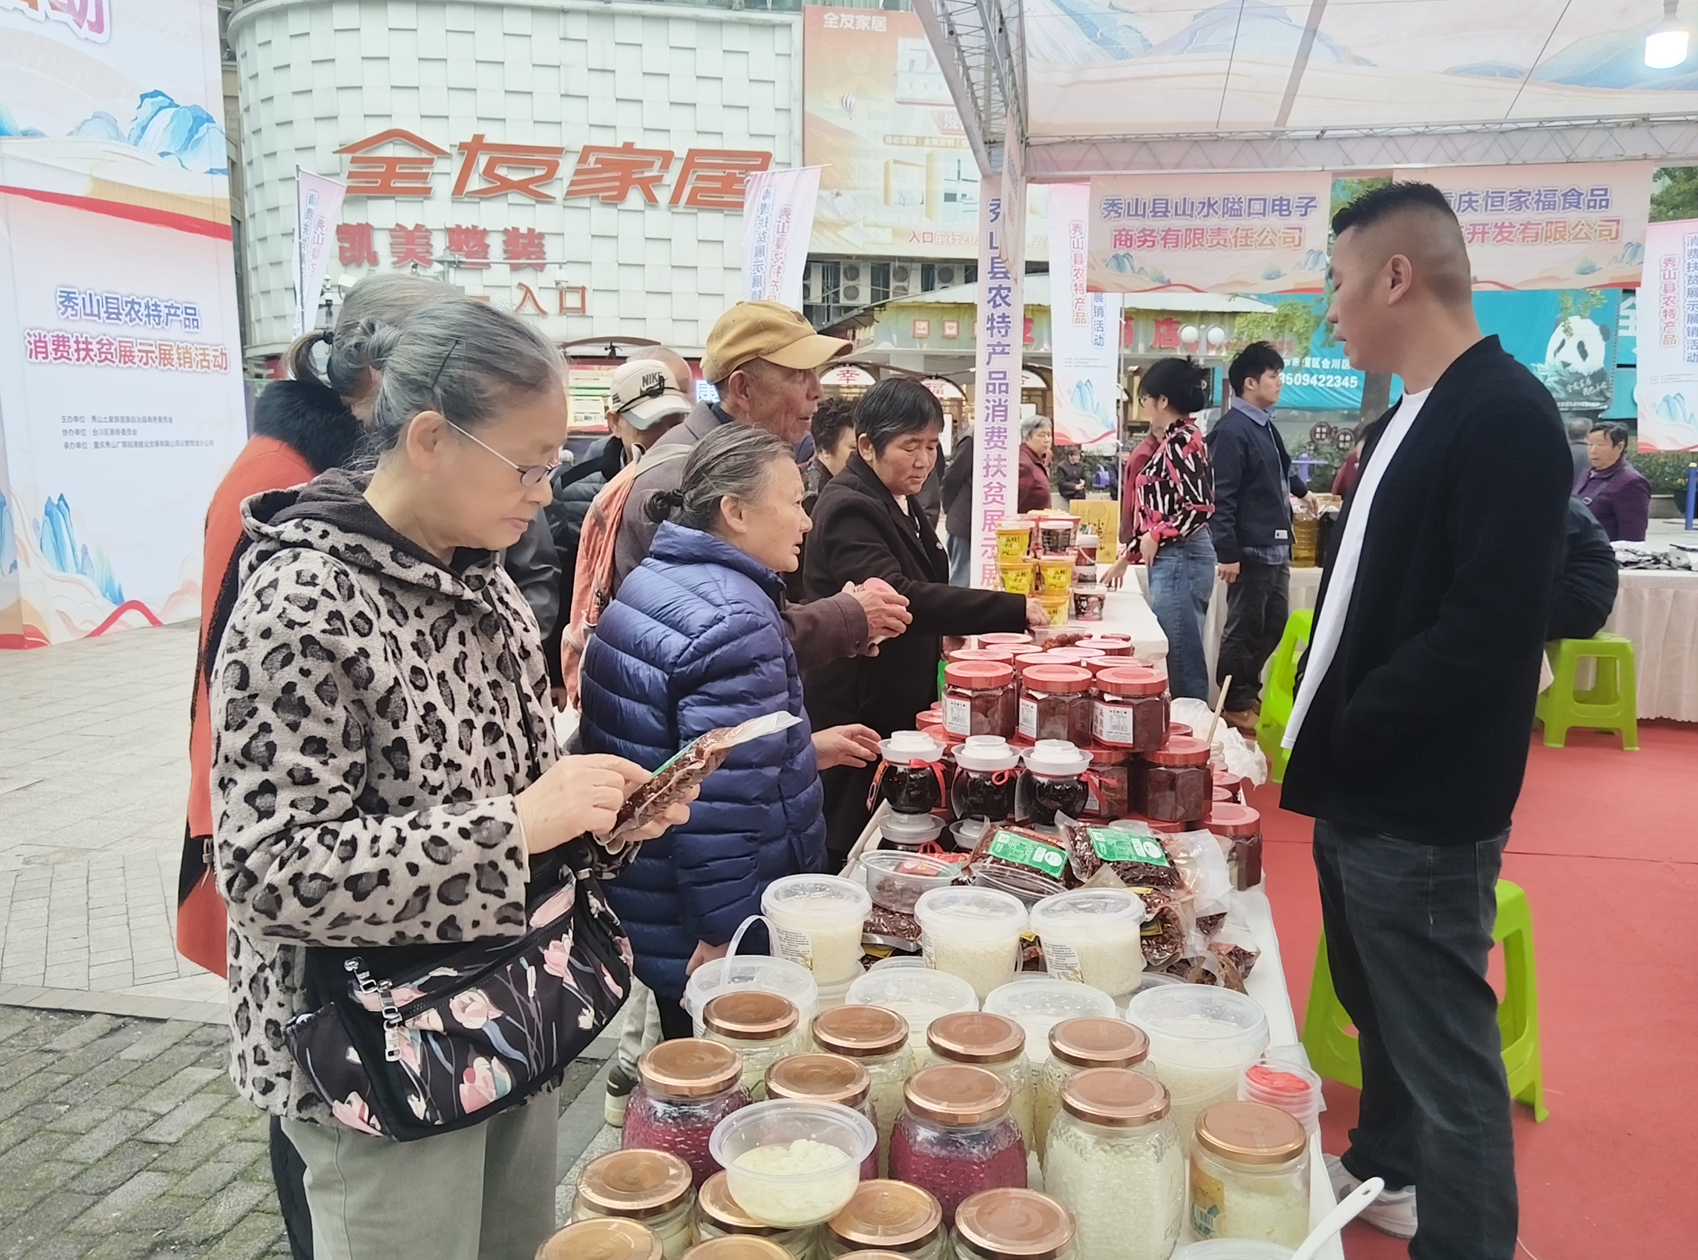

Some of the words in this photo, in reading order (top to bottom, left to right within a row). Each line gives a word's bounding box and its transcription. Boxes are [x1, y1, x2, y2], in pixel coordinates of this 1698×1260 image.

[823, 12, 887, 32] 全友家居
[333, 128, 773, 209] 全友家居
[1102, 195, 1317, 219] 秀山县山水隘口电子
[337, 222, 547, 271] 凯美整装
[1113, 226, 1302, 249] 商务有限责任公司
[1461, 219, 1621, 244] 开发有限公司
[1071, 223, 1086, 324] 秀山县农特产品
[58, 289, 200, 330] 秀山县农特产品
[1662, 257, 1677, 345] 秀山县农特产品
[1685, 235, 1698, 364] 消费扶贫展示展销活动
[26, 331, 228, 371] 消费扶贫展示展销活动
[836, 369, 860, 384] 幸
